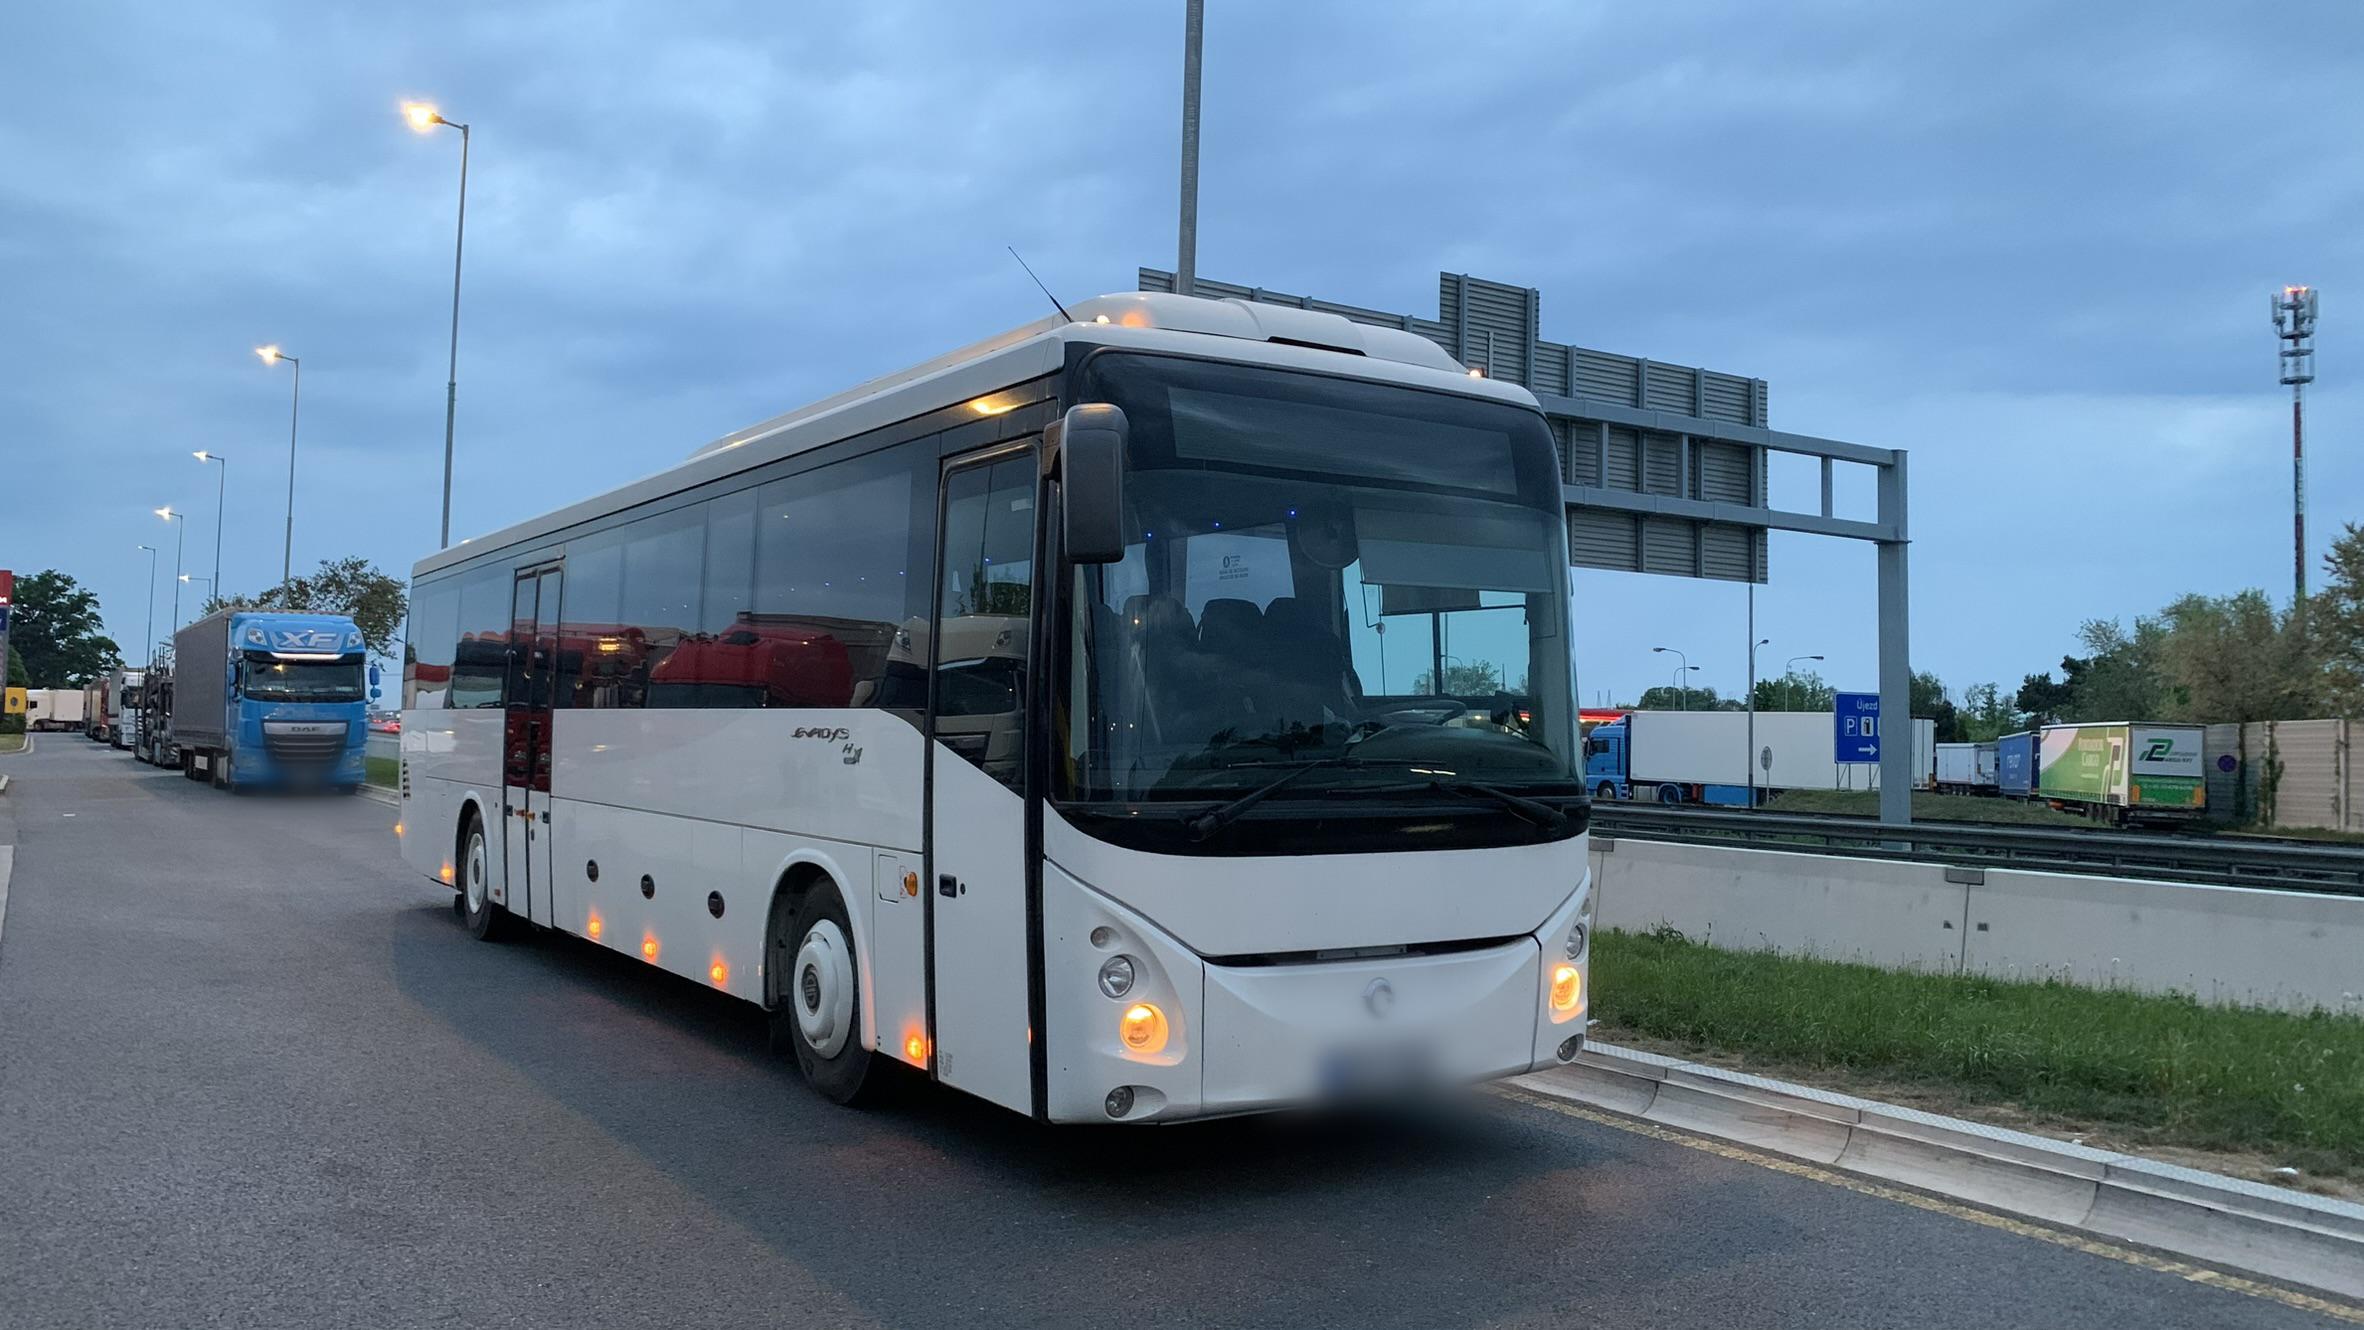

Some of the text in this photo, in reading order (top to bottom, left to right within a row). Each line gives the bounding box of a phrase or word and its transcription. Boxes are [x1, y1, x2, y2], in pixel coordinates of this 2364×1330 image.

[279, 631, 337, 647] XF
[1856, 697, 1878, 712] Újezd
[290, 725, 320, 733] DAF
